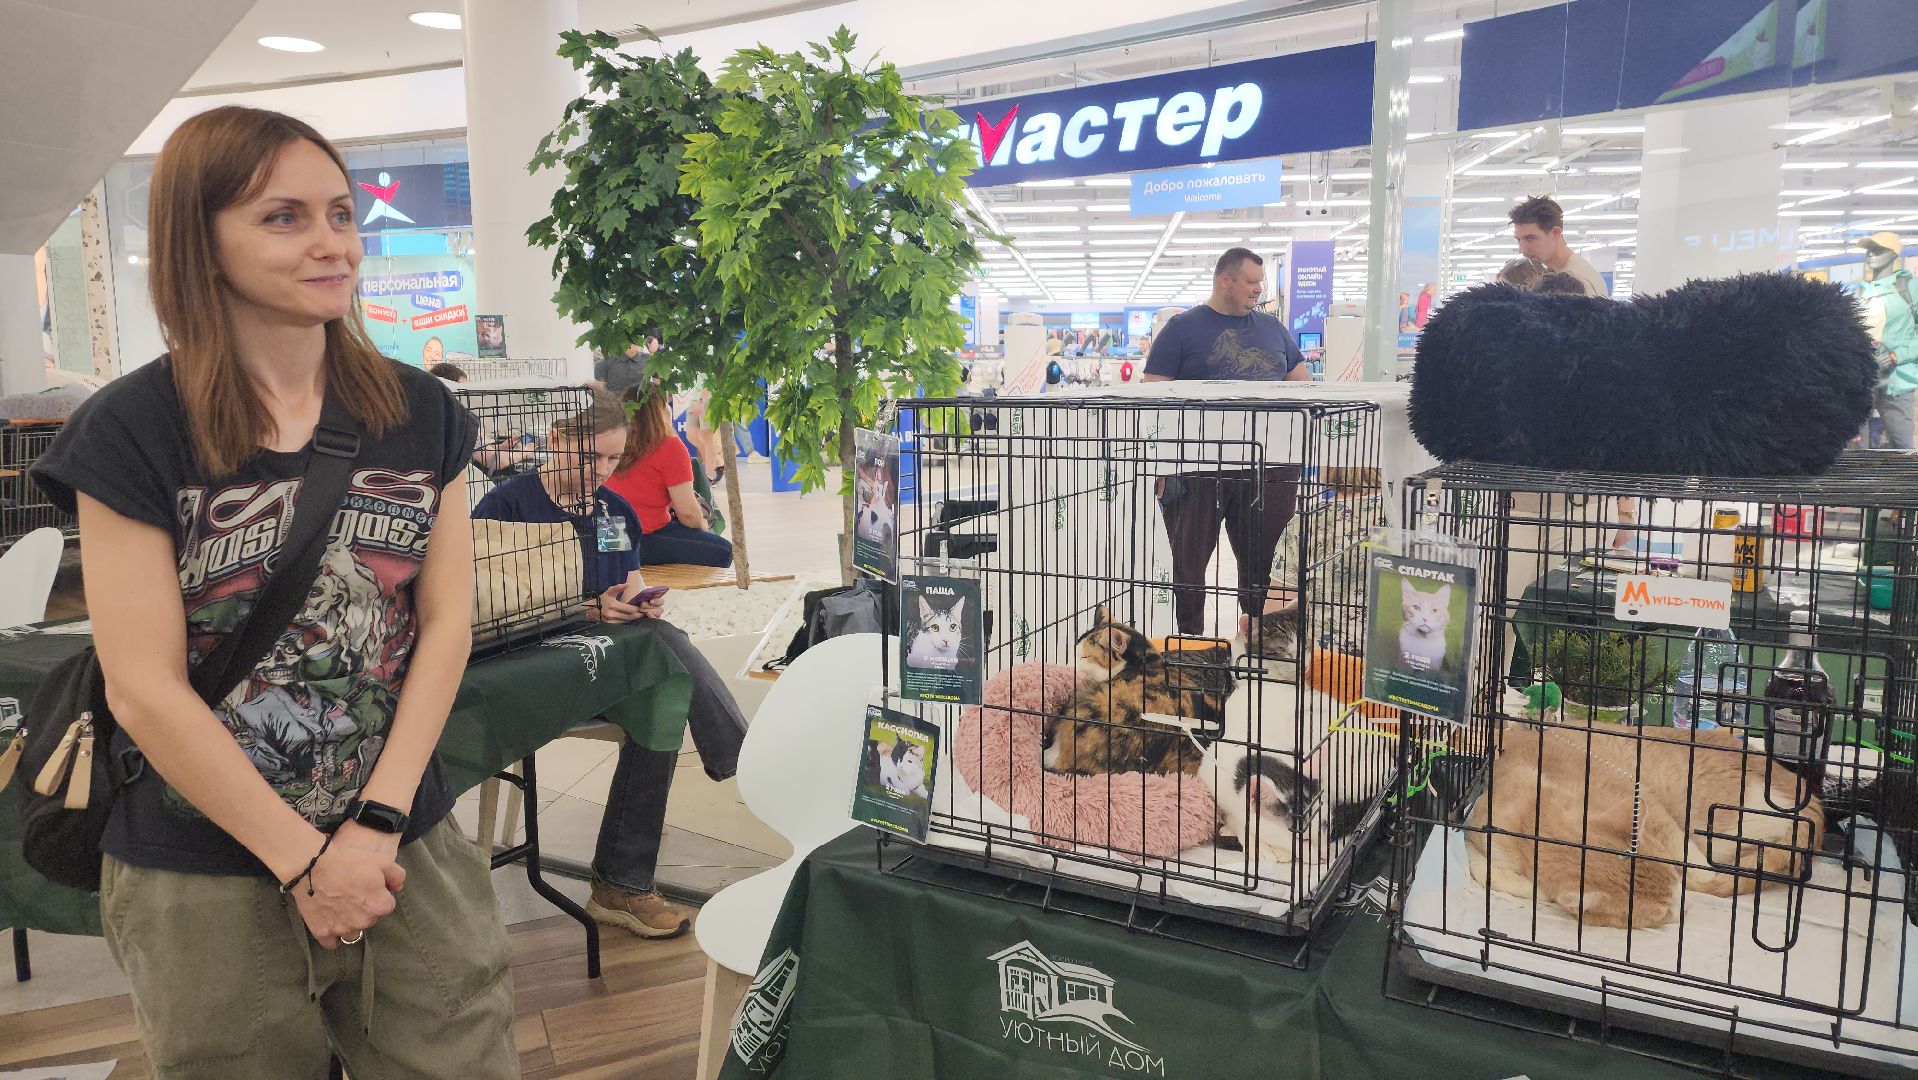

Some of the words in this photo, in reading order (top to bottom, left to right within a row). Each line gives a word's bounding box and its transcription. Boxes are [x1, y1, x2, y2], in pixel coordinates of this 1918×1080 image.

[1144, 180, 1184, 196] Добро
[1187, 171, 1266, 190] пожаловать
[1184, 193, 1222, 204] Welcome
[362, 274, 458, 295] персональная
[415, 294, 442, 309] цена
[433, 308, 466, 323] СКИДКИ
[1398, 565, 1455, 584] СПАРТАК
[1652, 595, 1726, 610] WILD-TOWN
[1403, 651, 1410, 660] 2
[877, 721, 929, 743] КАССИОПЕЯ
[999, 1016, 1102, 1060] УЮТНЫЙ
[1108, 1046, 1166, 1078] ДОМ
